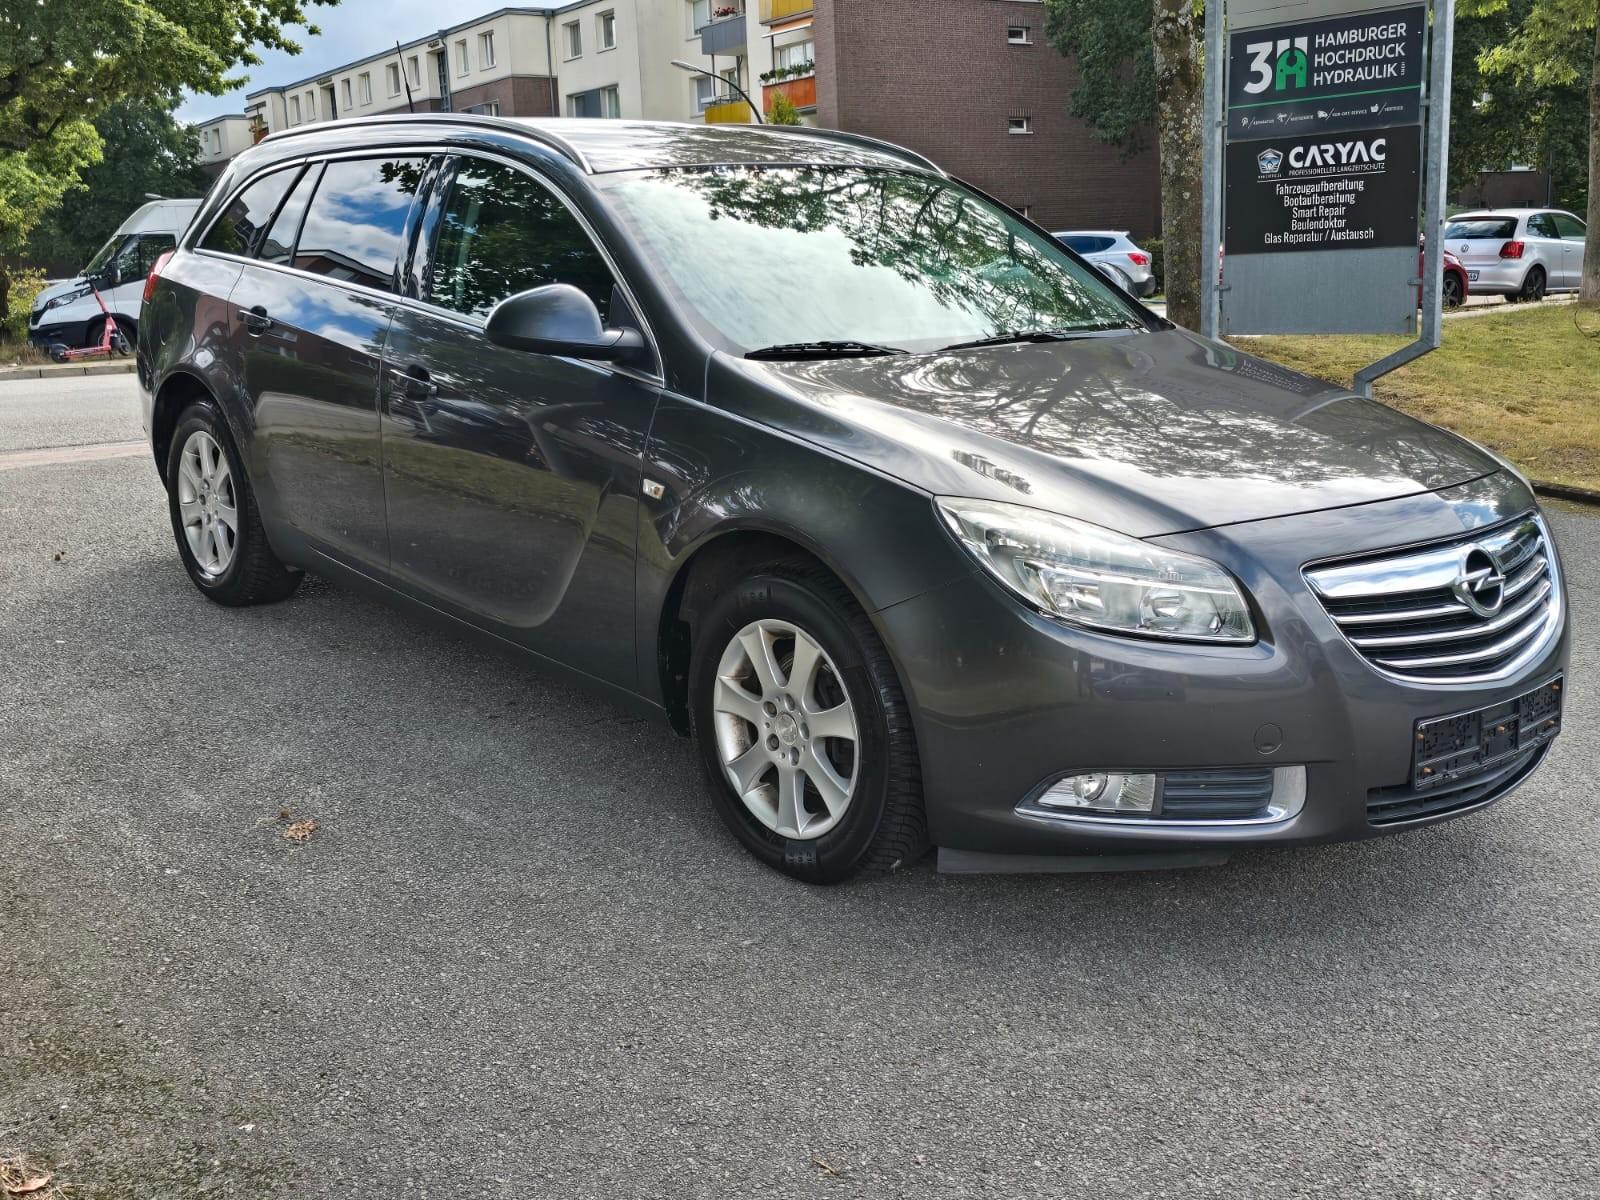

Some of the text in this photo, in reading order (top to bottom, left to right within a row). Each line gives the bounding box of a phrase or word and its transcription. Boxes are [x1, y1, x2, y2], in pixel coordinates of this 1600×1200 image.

[1315, 22, 1407, 48] HAMBURGER
[1314, 42, 1406, 67] HOCHDRUCK
[1313, 62, 1398, 87] HYDRAULIK
[1288, 138, 1386, 168] CARYAC
[1289, 166, 1336, 176] PROFESSIONELLER
[1337, 162, 1385, 173] LANGZEITSCHUTZ
[1276, 179, 1364, 195] Fahrzeugaufbereitung
[1283, 192, 1355, 207] Bootaufbereitung
[1292, 204, 1346, 220] Smart Repair
[1291, 217, 1346, 230] Beulendoktor
[1264, 233, 1282, 244] Glas
[1283, 231, 1323, 244] Reparatur
[1330, 227, 1374, 240] Austausch
